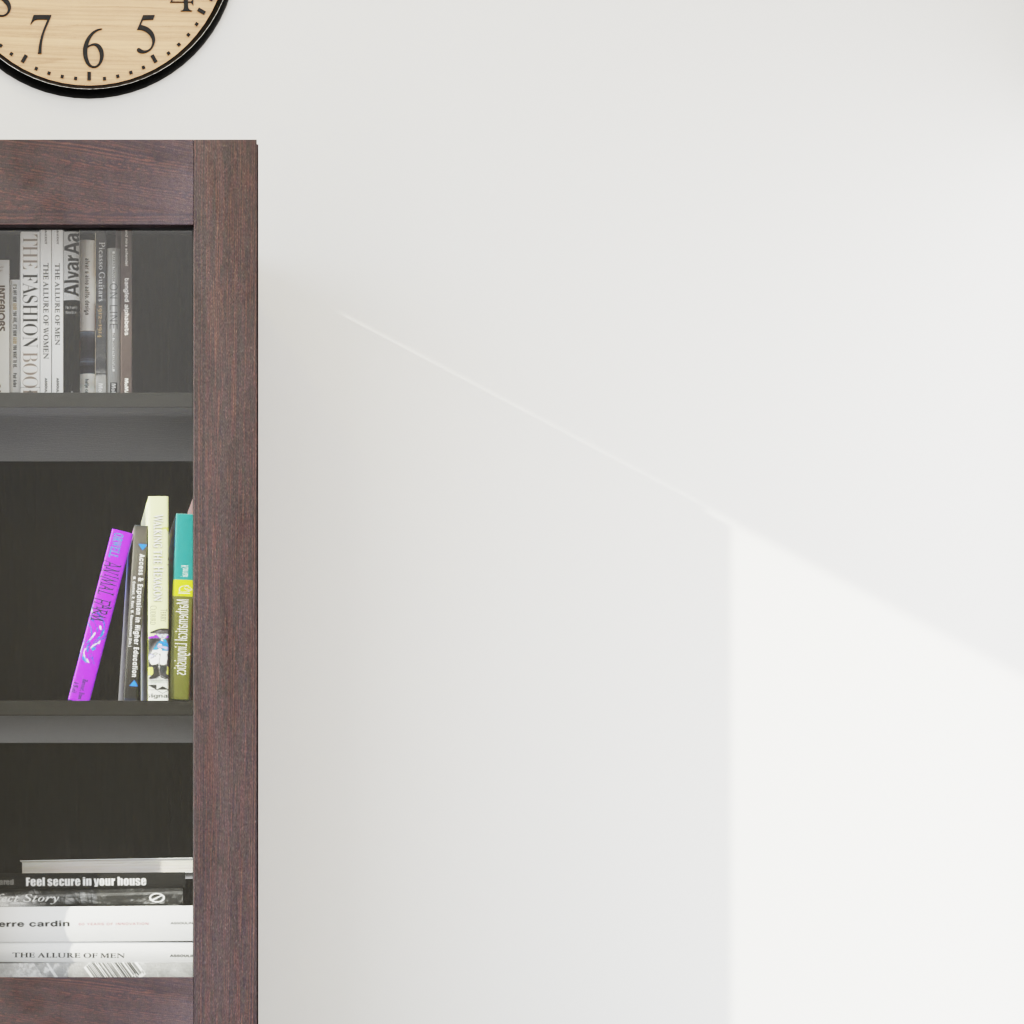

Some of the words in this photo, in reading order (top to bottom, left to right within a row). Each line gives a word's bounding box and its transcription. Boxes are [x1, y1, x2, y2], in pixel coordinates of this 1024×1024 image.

[30, 15, 52, 54] 7
[82, 28, 104, 69] 6
[136, 15, 156, 54] 5
[23, 234, 38, 269] THE
[64, 255, 79, 296] Alvar
[109, 283, 118, 300] ON
[23, 274, 38, 347] FASHION
[43, 315, 49, 325] OF
[55, 315, 60, 326] OF
[109, 304, 118, 330] LINE
[108, 533, 124, 557] ORWELL
[153, 515, 164, 548] WALKING
[153, 551, 163, 565] THE
[98, 560, 121, 596] ANIMAL
[153, 566, 163, 602] HEXAGON
[90, 598, 114, 622] FARM
[135, 584, 143, 615] Expansion
[132, 625, 141, 646] Higher
[131, 647, 140, 678] Education
[25, 877, 45, 887] Feel
[47, 877, 81, 887] secure
[82, 877, 91, 886] in
[94, 877, 115, 887] your
[117, 876, 147, 887] house
[23, 894, 59, 905] Story
